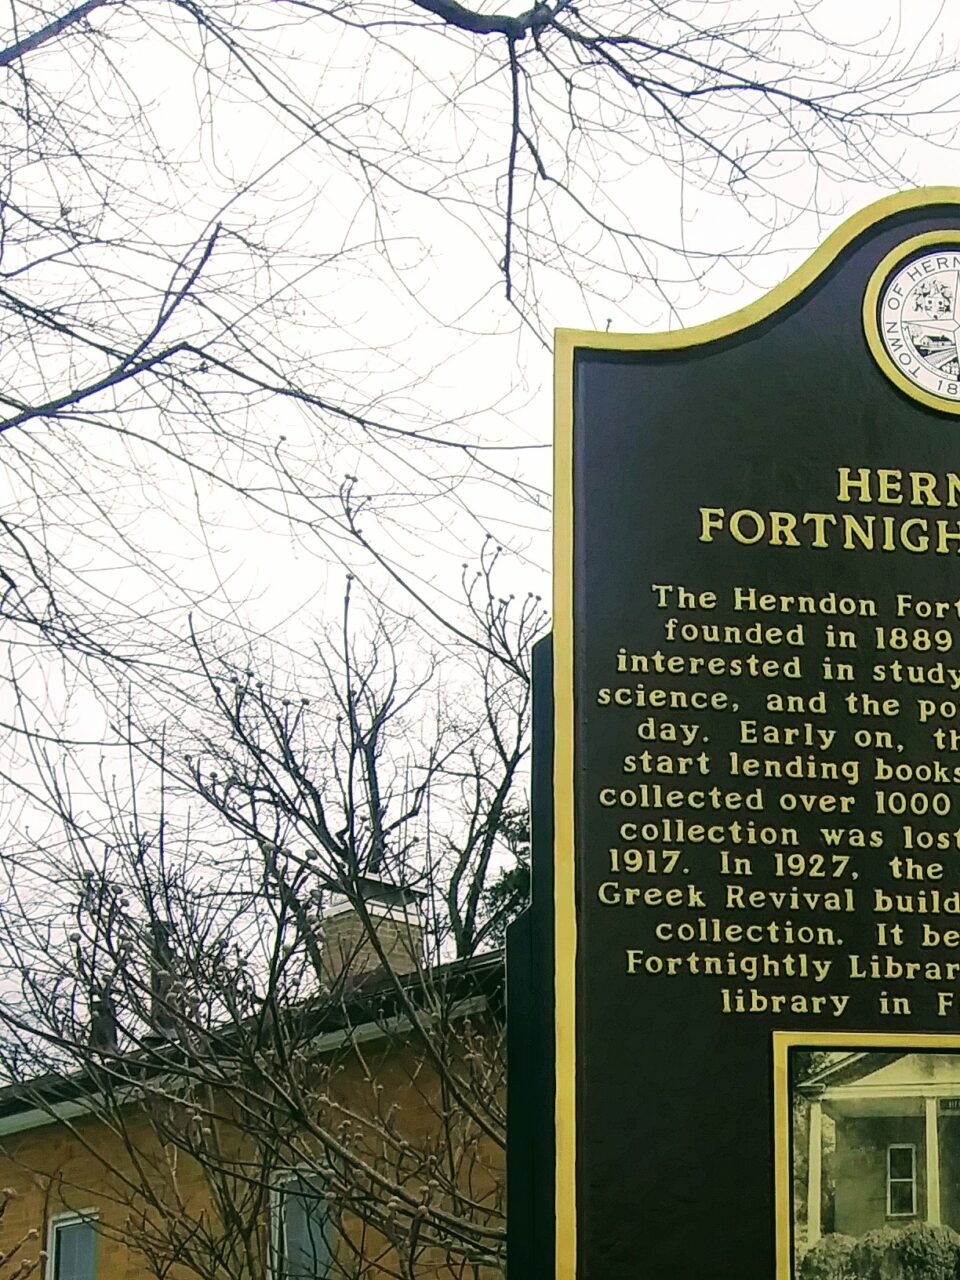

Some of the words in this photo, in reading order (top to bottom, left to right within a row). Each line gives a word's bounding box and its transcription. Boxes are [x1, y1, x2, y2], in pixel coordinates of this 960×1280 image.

[887, 283, 904, 310] OF
[886, 321, 922, 379] TOWN
[651, 583, 717, 609] The
[733, 586, 878, 617] Herndon
[664, 617, 805, 646] founded
[825, 624, 857, 649] in
[875, 626, 953, 652] 1889
[616, 647, 802, 679] interested
[822, 656, 855, 681] in
[597, 683, 739, 713] science,
[766, 691, 827, 714] and
[844, 691, 900, 716] the
[637, 717, 709, 746] day.
[740, 720, 837, 751] Early
[854, 729, 904, 753] on,
[623, 749, 710, 775] start
[729, 751, 860, 786] lending
[599, 784, 764, 810] collected
[779, 793, 856, 813] over
[875, 790, 951, 816] 1000
[619, 818, 800, 846] collection
[819, 828, 884, 848] was
[609, 848, 690, 874] 1917.
[720, 850, 753, 876] In
[774, 852, 859, 880] 1927,
[888, 855, 944, 881] the
[598, 881, 707, 908] Greek
[725, 884, 855, 912] Revival
[655, 917, 844, 946] collection.
[876, 922, 904, 946] It
[626, 949, 832, 982] Fortnightly
[720, 988, 850, 1017] library
[879, 990, 912, 1015] in
